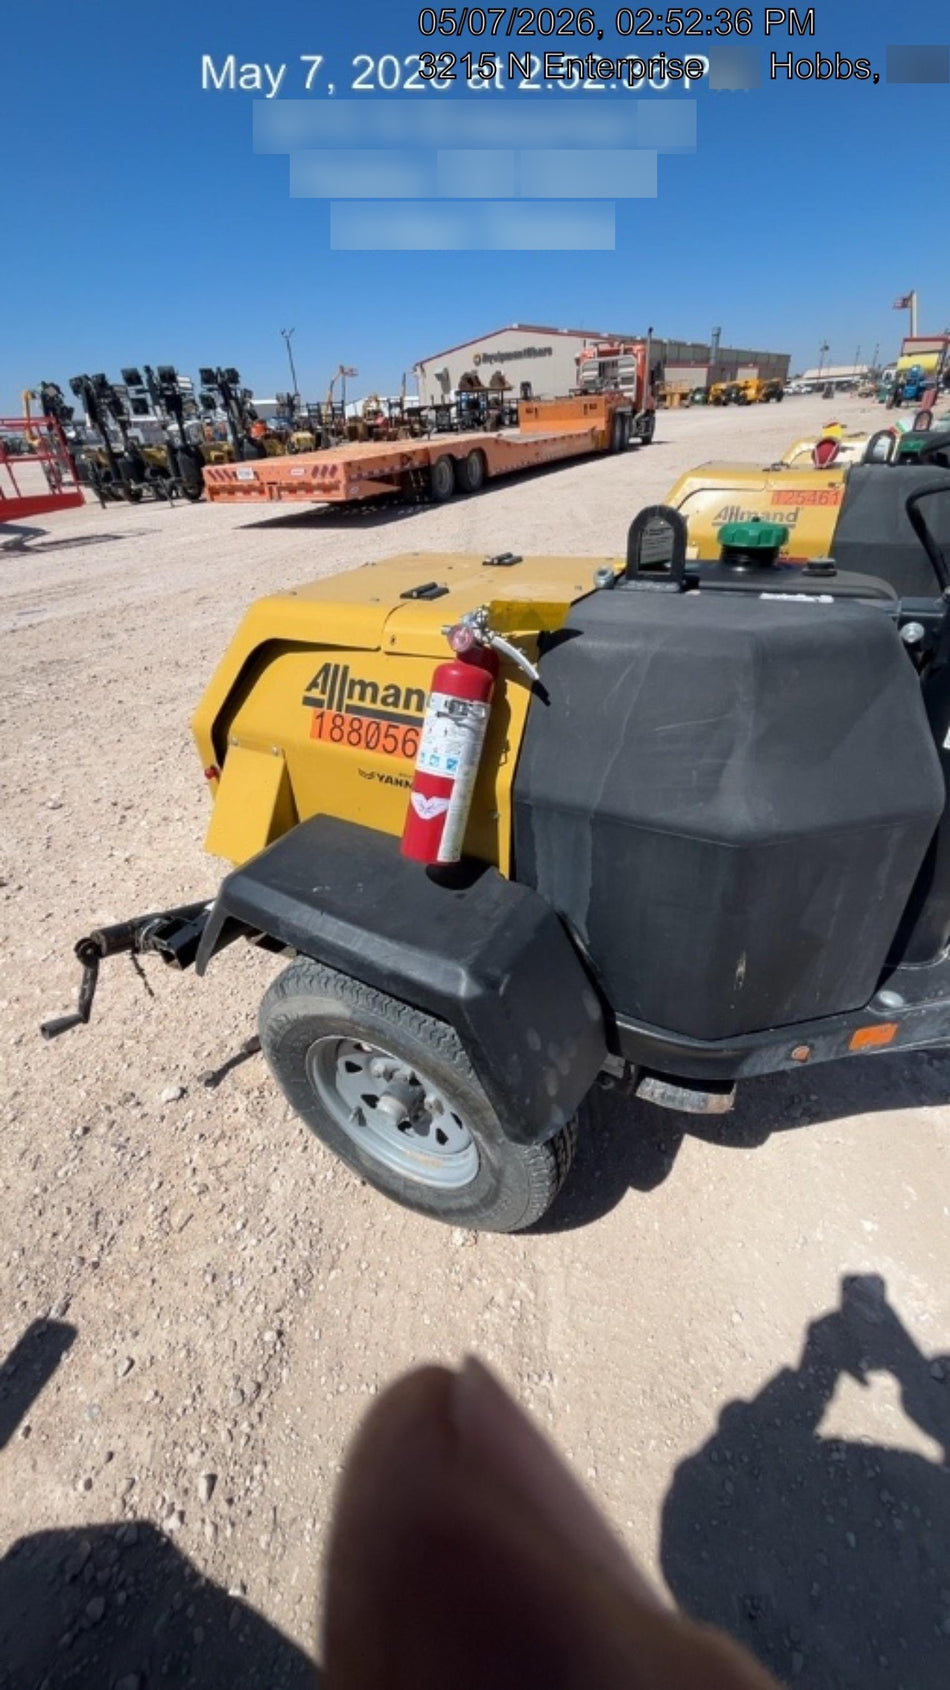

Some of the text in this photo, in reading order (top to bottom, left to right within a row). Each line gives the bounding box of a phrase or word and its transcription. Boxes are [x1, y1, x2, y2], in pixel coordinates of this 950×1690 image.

[713, 505, 800, 524] Allmand
[303, 661, 432, 714] Allman
[314, 710, 420, 759] 188056
